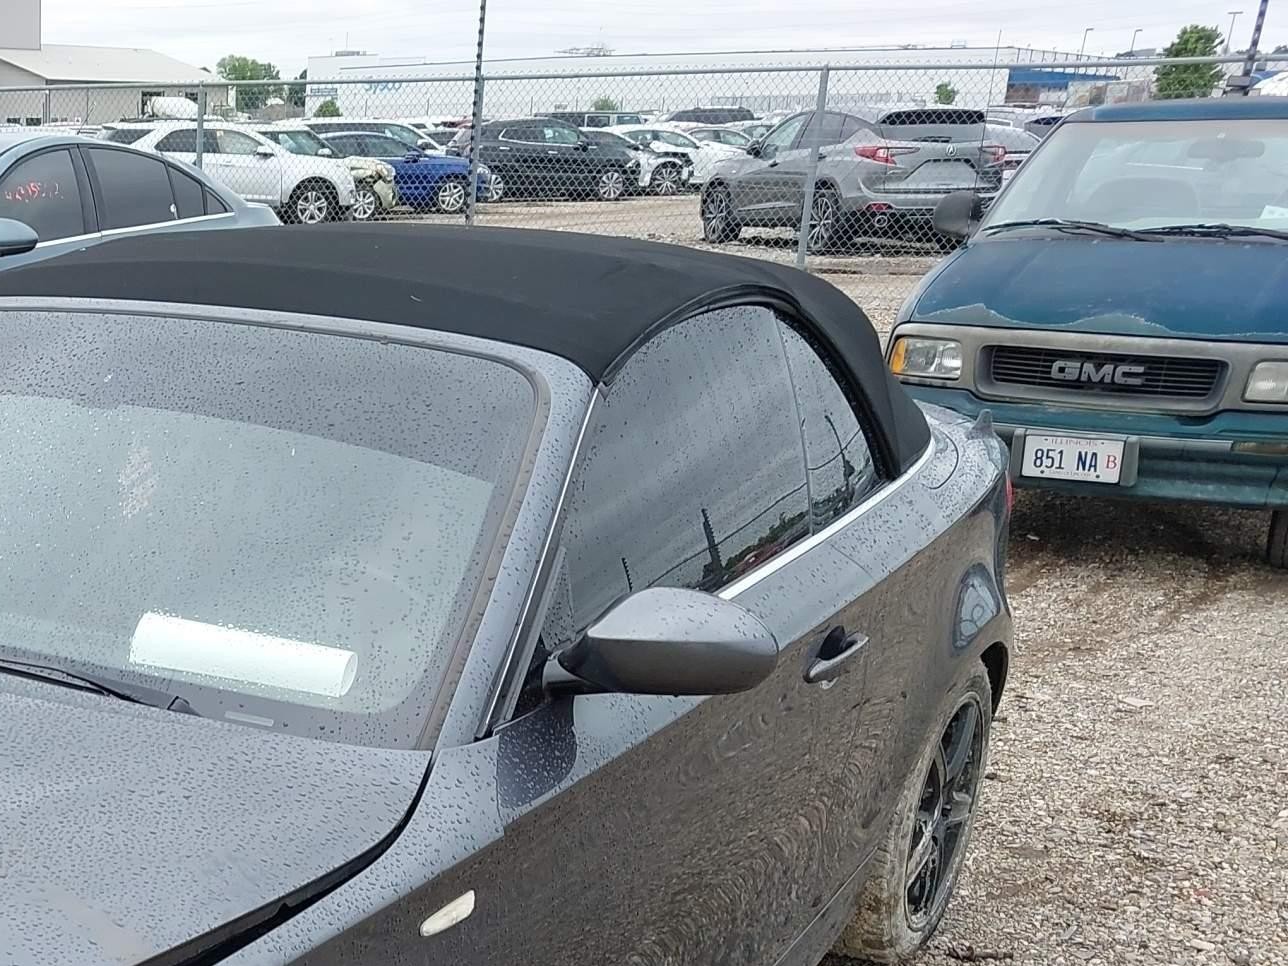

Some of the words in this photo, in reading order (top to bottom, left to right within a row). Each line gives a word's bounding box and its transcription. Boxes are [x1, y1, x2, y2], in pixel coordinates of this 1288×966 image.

[1050, 360, 1145, 386] GMC
[1033, 448, 1065, 470] 851
[1076, 450, 1099, 473] NA
[1105, 454, 1118, 470] B
